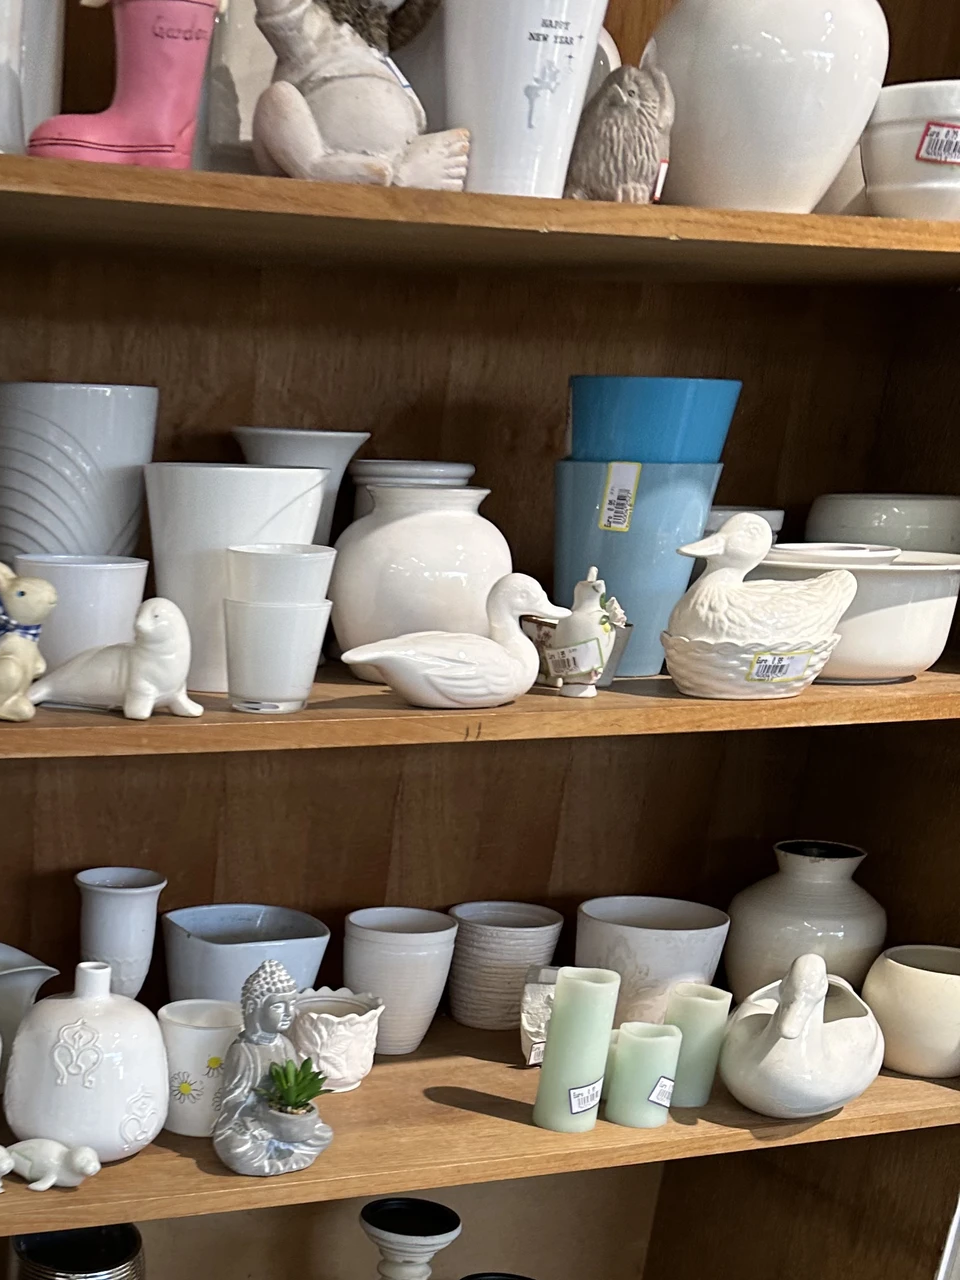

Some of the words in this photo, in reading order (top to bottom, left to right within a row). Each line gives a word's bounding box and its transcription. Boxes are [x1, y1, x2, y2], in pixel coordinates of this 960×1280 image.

[541, 18, 571, 31] HAPPY
[527, 31, 549, 42] NEW
[553, 35, 575, 46] YEAR
